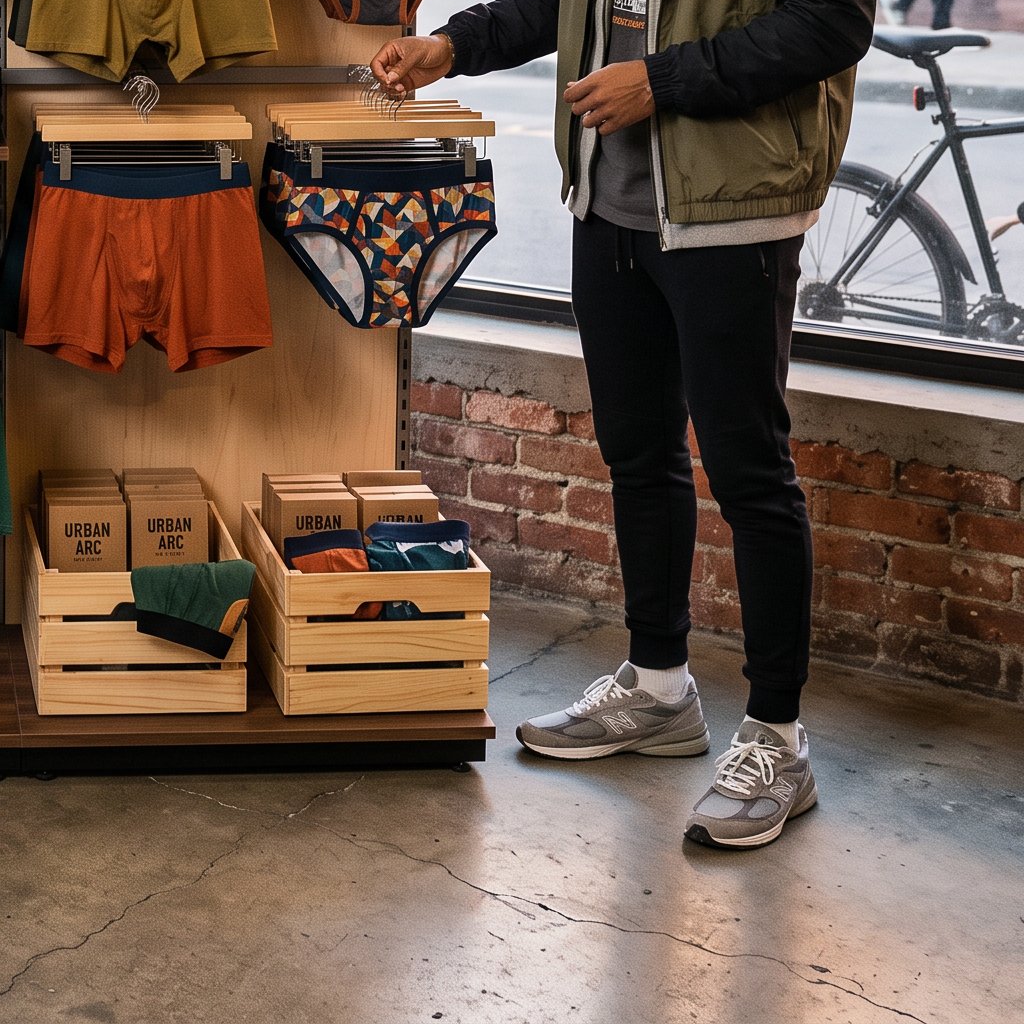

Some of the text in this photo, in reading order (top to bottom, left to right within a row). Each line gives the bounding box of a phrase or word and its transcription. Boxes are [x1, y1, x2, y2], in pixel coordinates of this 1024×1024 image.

[64, 522, 110, 537] URBAN
[148, 517, 192, 533] URBAN
[296, 514, 342, 530] URBAN
[76, 540, 102, 555] ARC
[158, 535, 184, 550] ARC
